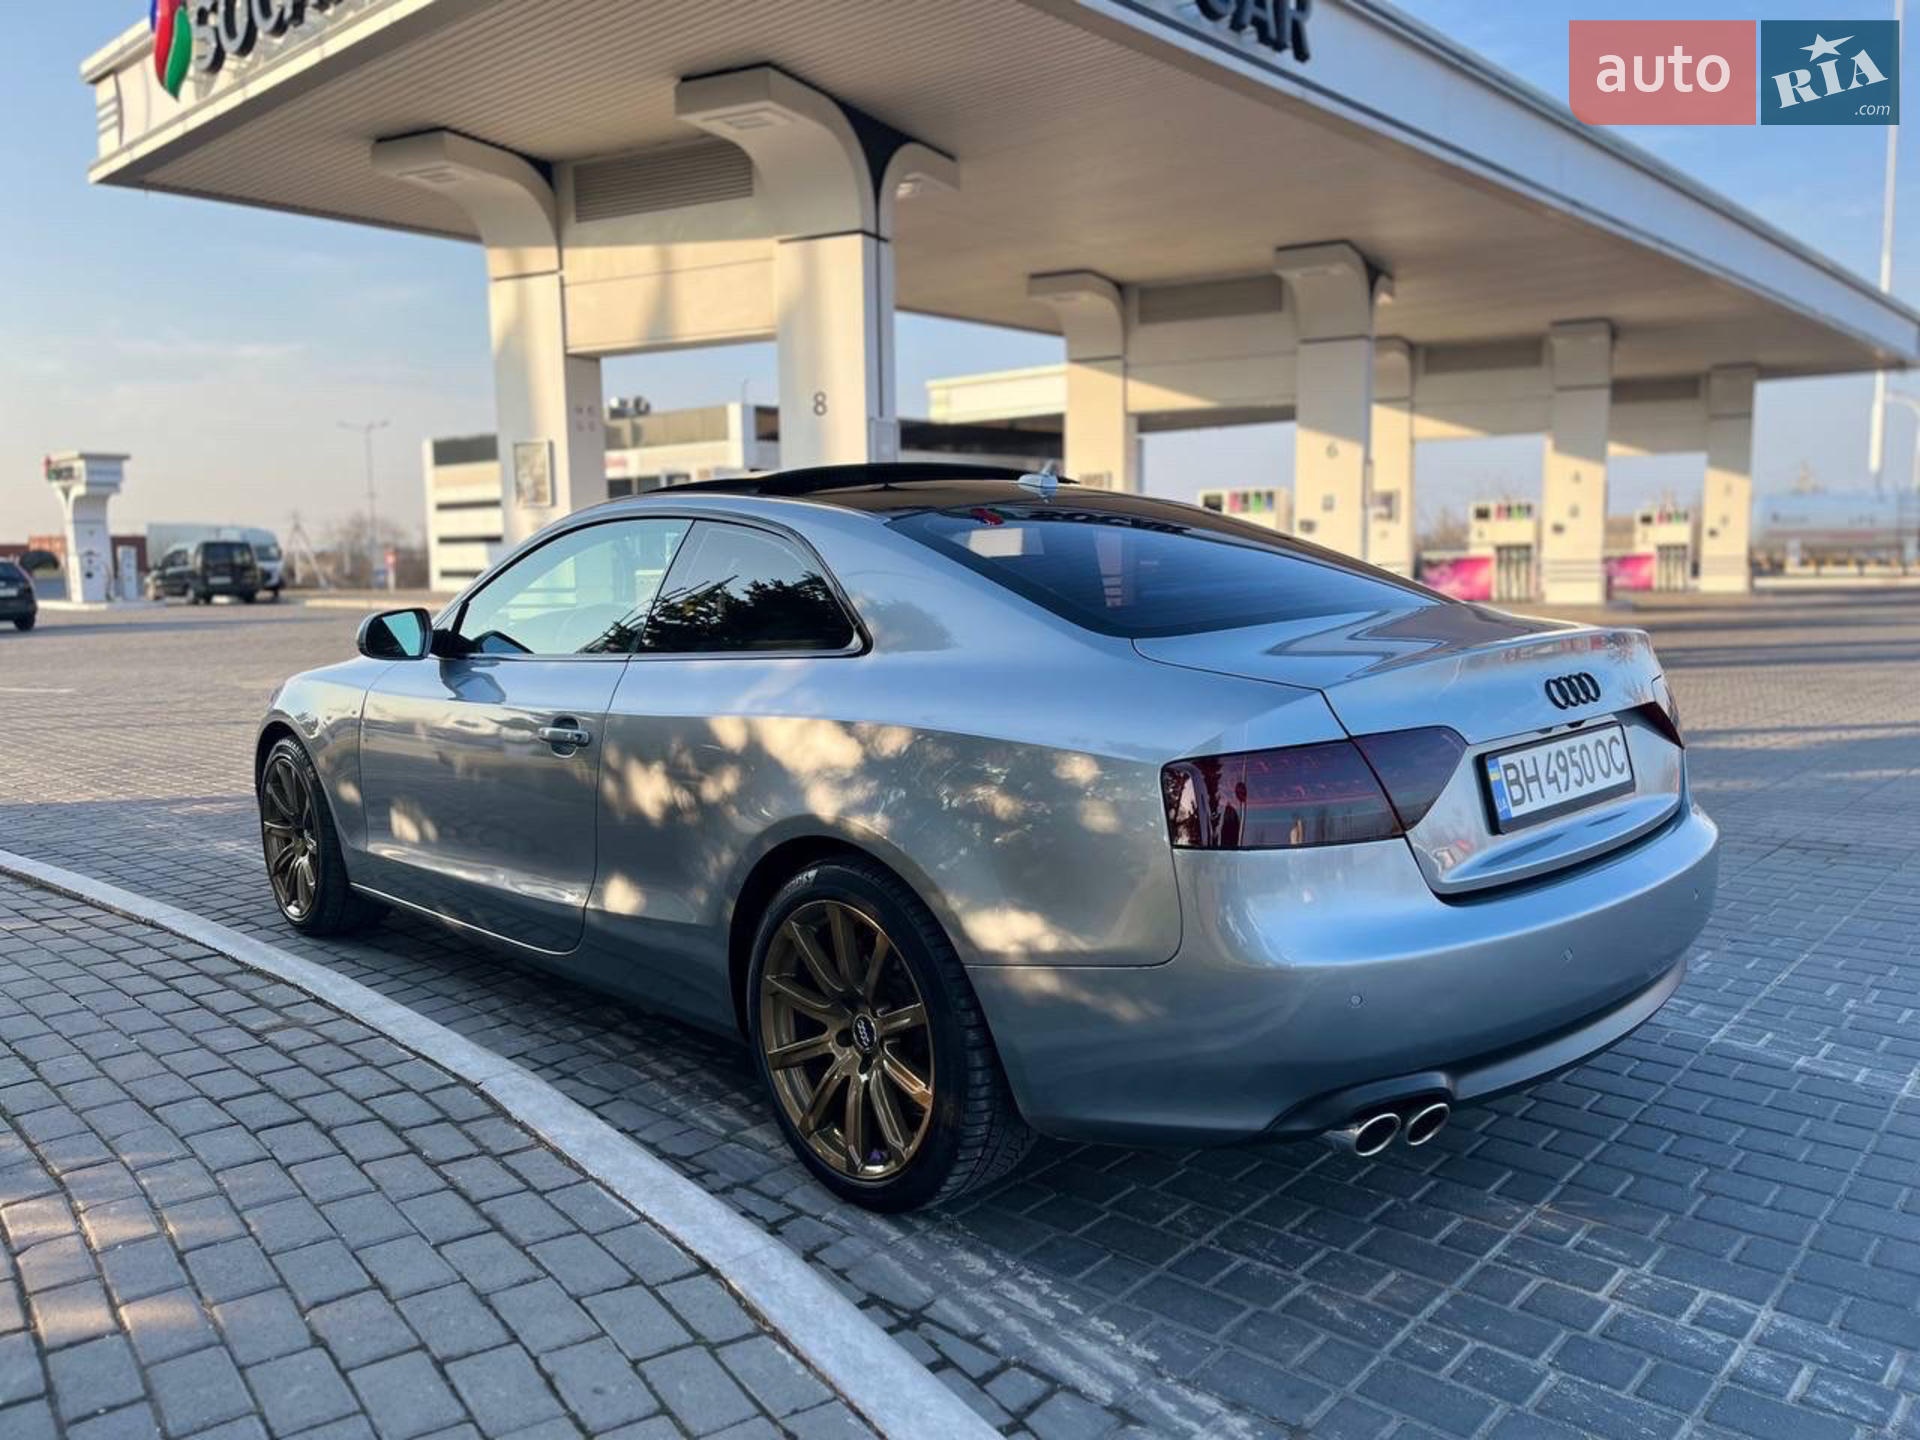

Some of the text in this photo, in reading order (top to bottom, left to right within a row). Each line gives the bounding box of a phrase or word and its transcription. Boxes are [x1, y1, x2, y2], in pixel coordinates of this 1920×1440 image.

[813, 391, 828, 416] 8
[1503, 736, 1625, 807] BH 4950 OC
